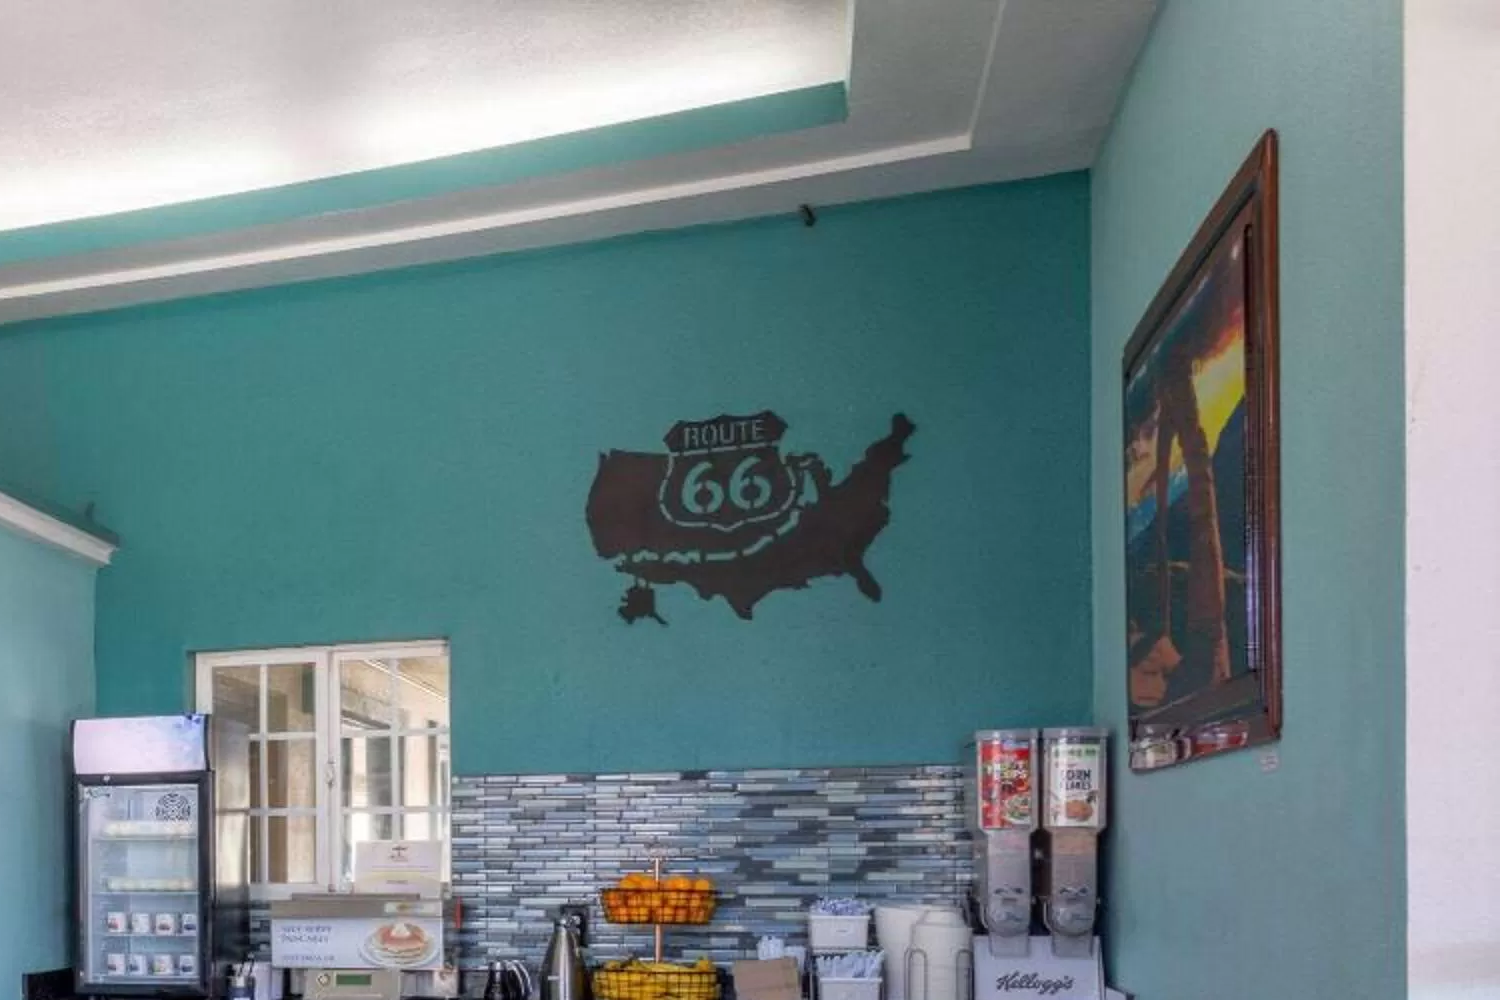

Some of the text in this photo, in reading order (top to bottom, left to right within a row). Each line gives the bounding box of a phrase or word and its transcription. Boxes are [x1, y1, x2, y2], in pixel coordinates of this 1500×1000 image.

[683, 419, 765, 449] ROUTE
[681, 456, 772, 514] 66
[996, 970, 1074, 996] Kellogg's
